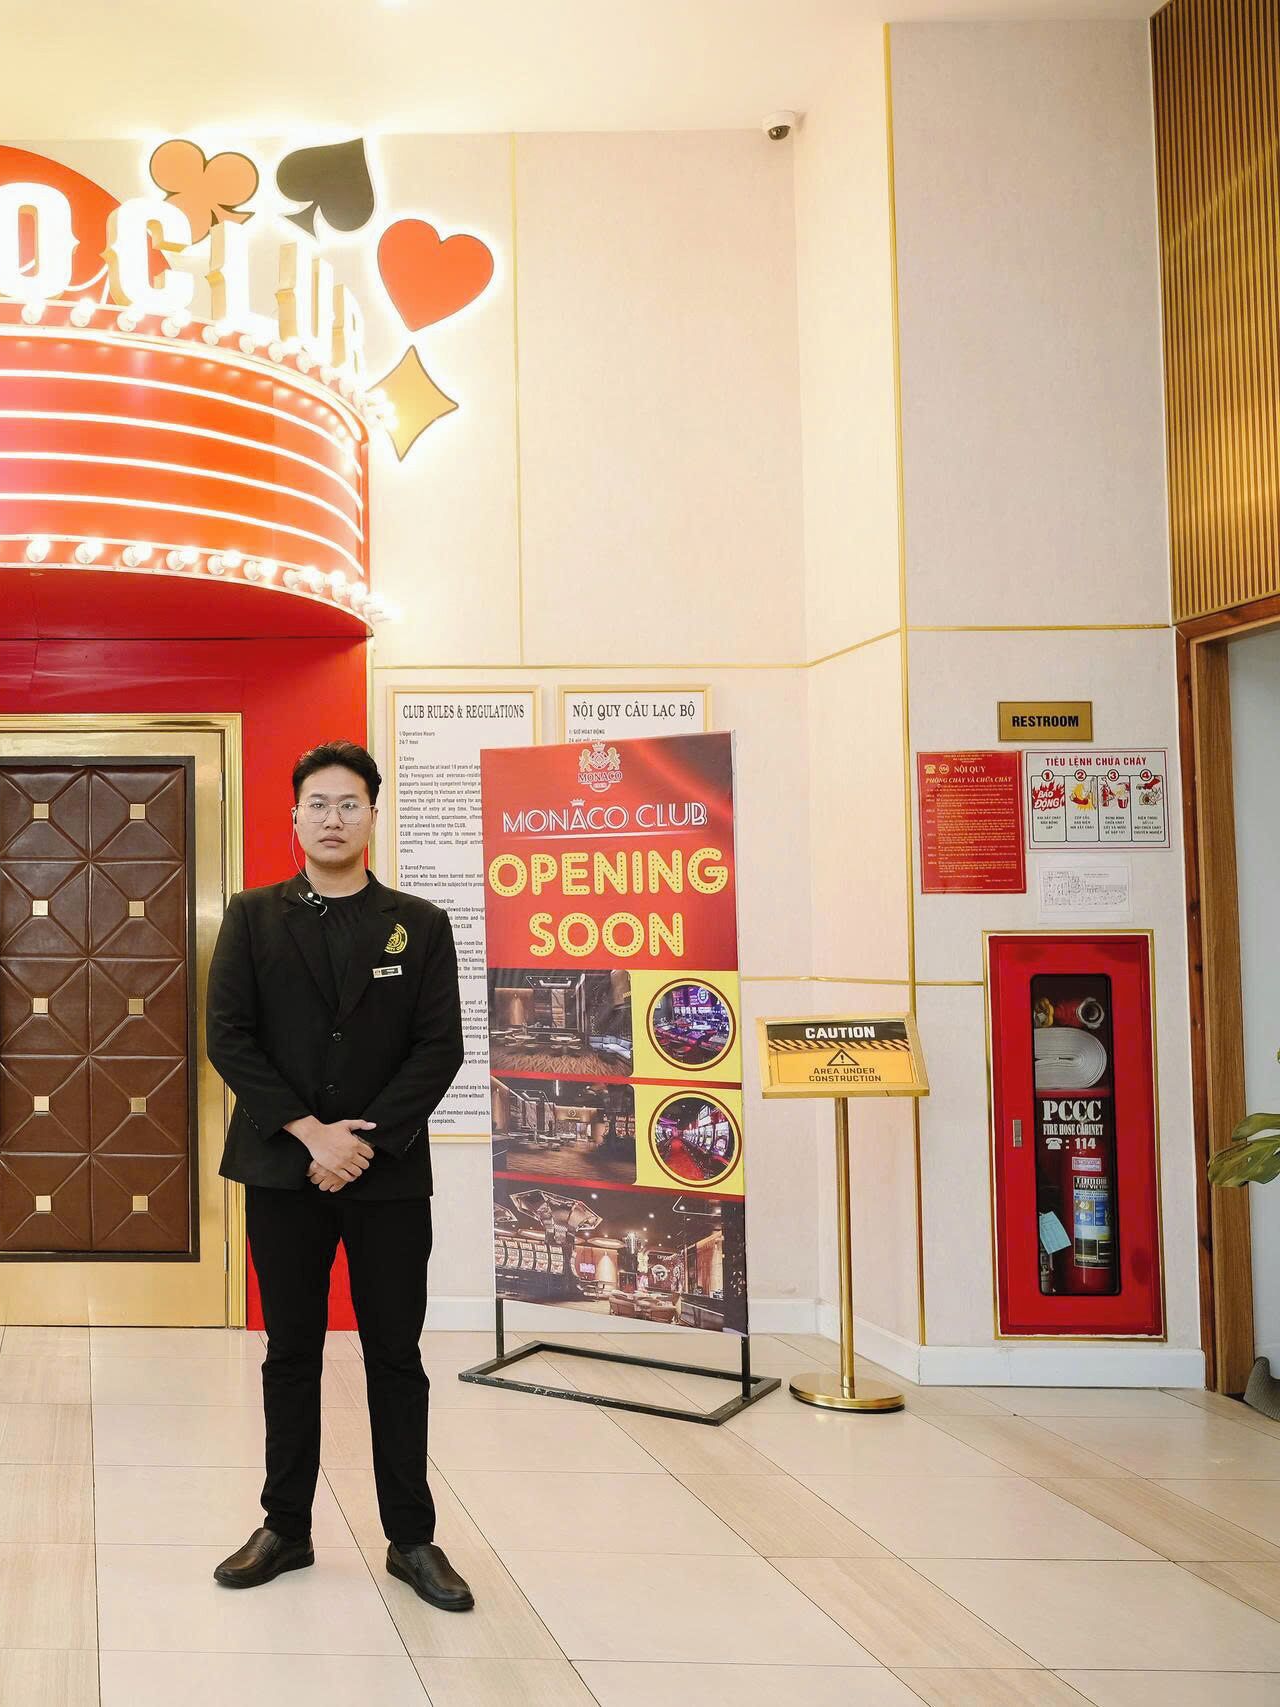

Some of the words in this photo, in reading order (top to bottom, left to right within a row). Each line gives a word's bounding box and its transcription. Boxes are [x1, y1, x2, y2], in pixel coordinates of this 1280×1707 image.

[403, 705, 424, 718] CLUB
[427, 705, 454, 718] RULES
[457, 705, 463, 718] &
[466, 705, 524, 718] REGULATIONS
[573, 701, 593, 720] NỘI
[597, 704, 620, 720] QUY
[625, 701, 649, 717] CÂU
[653, 704, 676, 720] LẠC
[680, 701, 695, 720] BỘ
[1012, 716, 1079, 727] RESTROOM
[969, 766, 986, 774] QUY
[578, 771, 622, 783] MONACO
[503, 805, 629, 833] MONACO
[635, 802, 707, 828] CLUB
[488, 847, 729, 897] OPENING
[529, 912, 684, 957] SOON
[805, 1026, 876, 1039] CAUTION
[1042, 1100, 1101, 1121] PCCC
[1043, 1124, 1058, 1135] FIRE
[1059, 1124, 1075, 1135] HOSE
[1076, 1123, 1103, 1135] CABINET
[1075, 1138, 1096, 1149] 114
